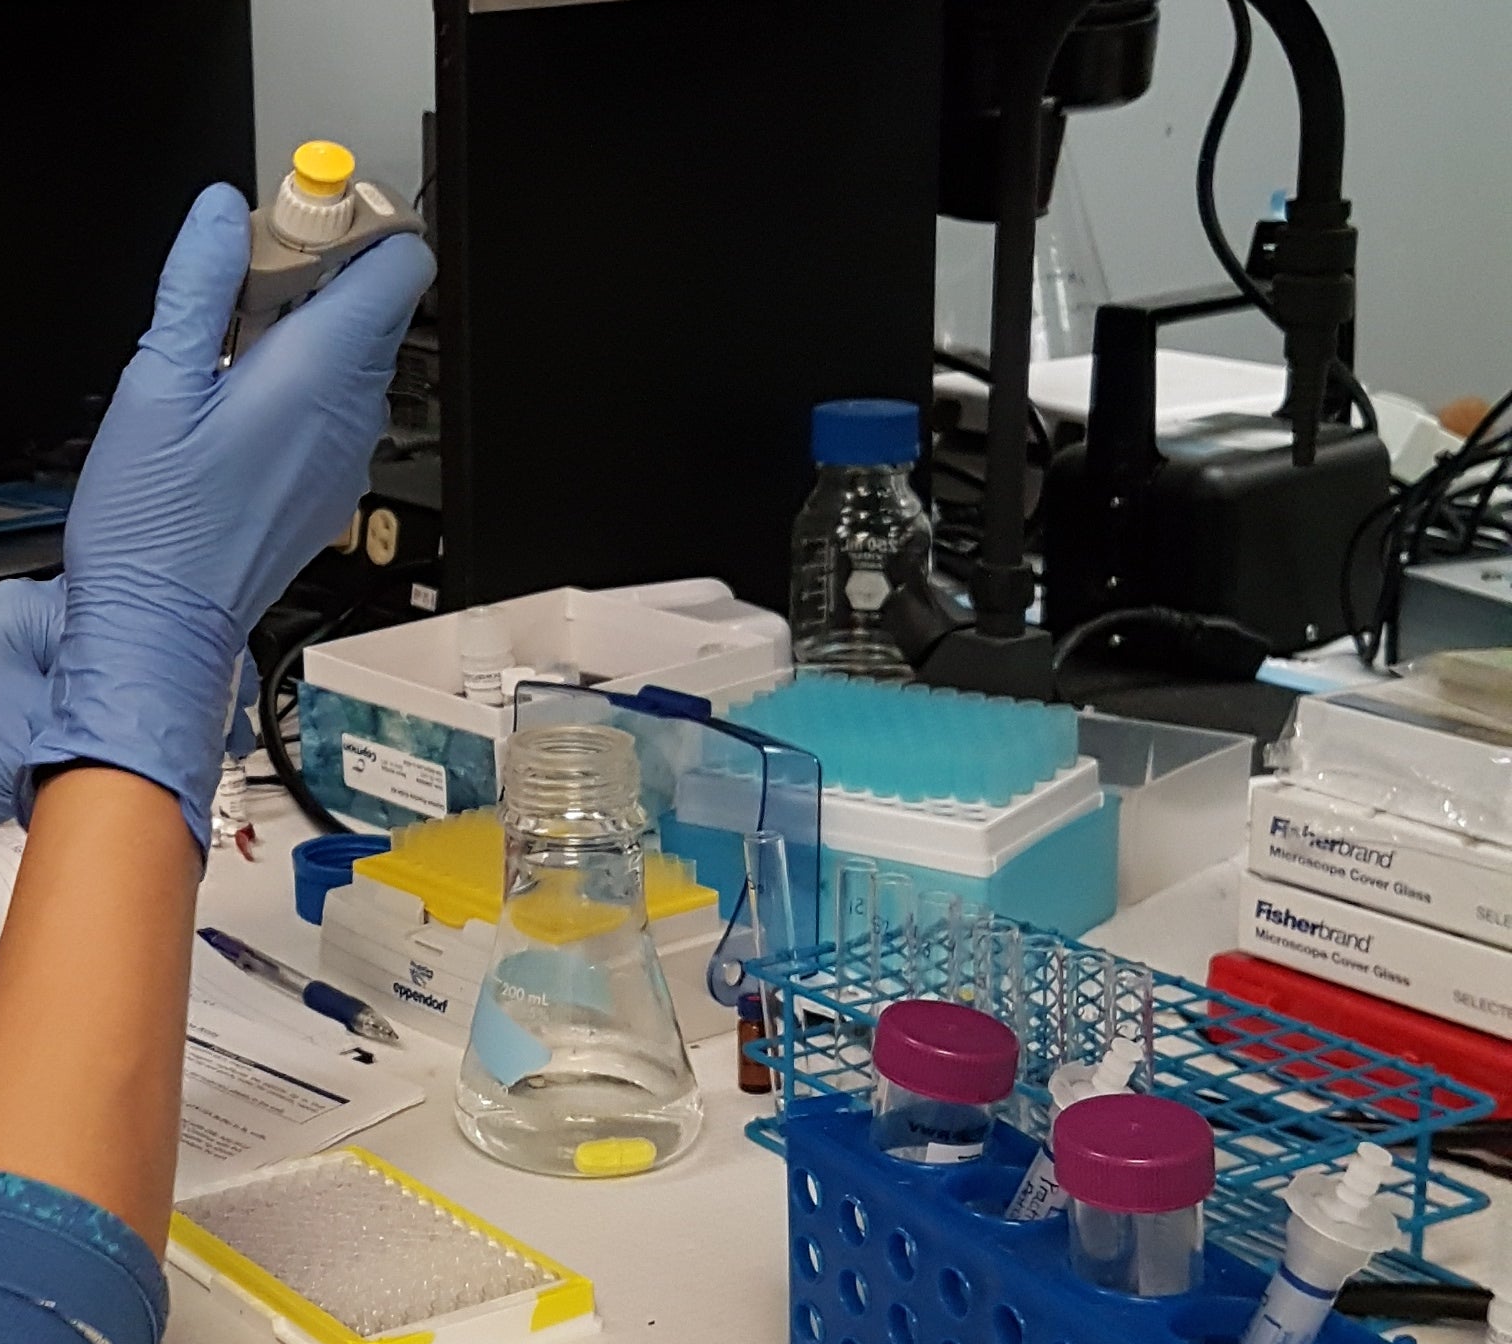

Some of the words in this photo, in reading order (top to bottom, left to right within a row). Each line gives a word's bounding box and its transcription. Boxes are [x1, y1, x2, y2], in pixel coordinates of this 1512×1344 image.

[1269, 844, 1346, 878] Microscope
[1350, 868, 1390, 892] Cover
[1393, 881, 1433, 905] Glass
[1254, 899, 1373, 954] Fisherbrand
[1254, 925, 1329, 961] Microscope
[1331, 951, 1370, 975] Cover
[1373, 964, 1411, 988] Glass
[392, 981, 449, 1015] eppendorf
[501, 980, 525, 1001] 200
[527, 991, 549, 1007] mL
